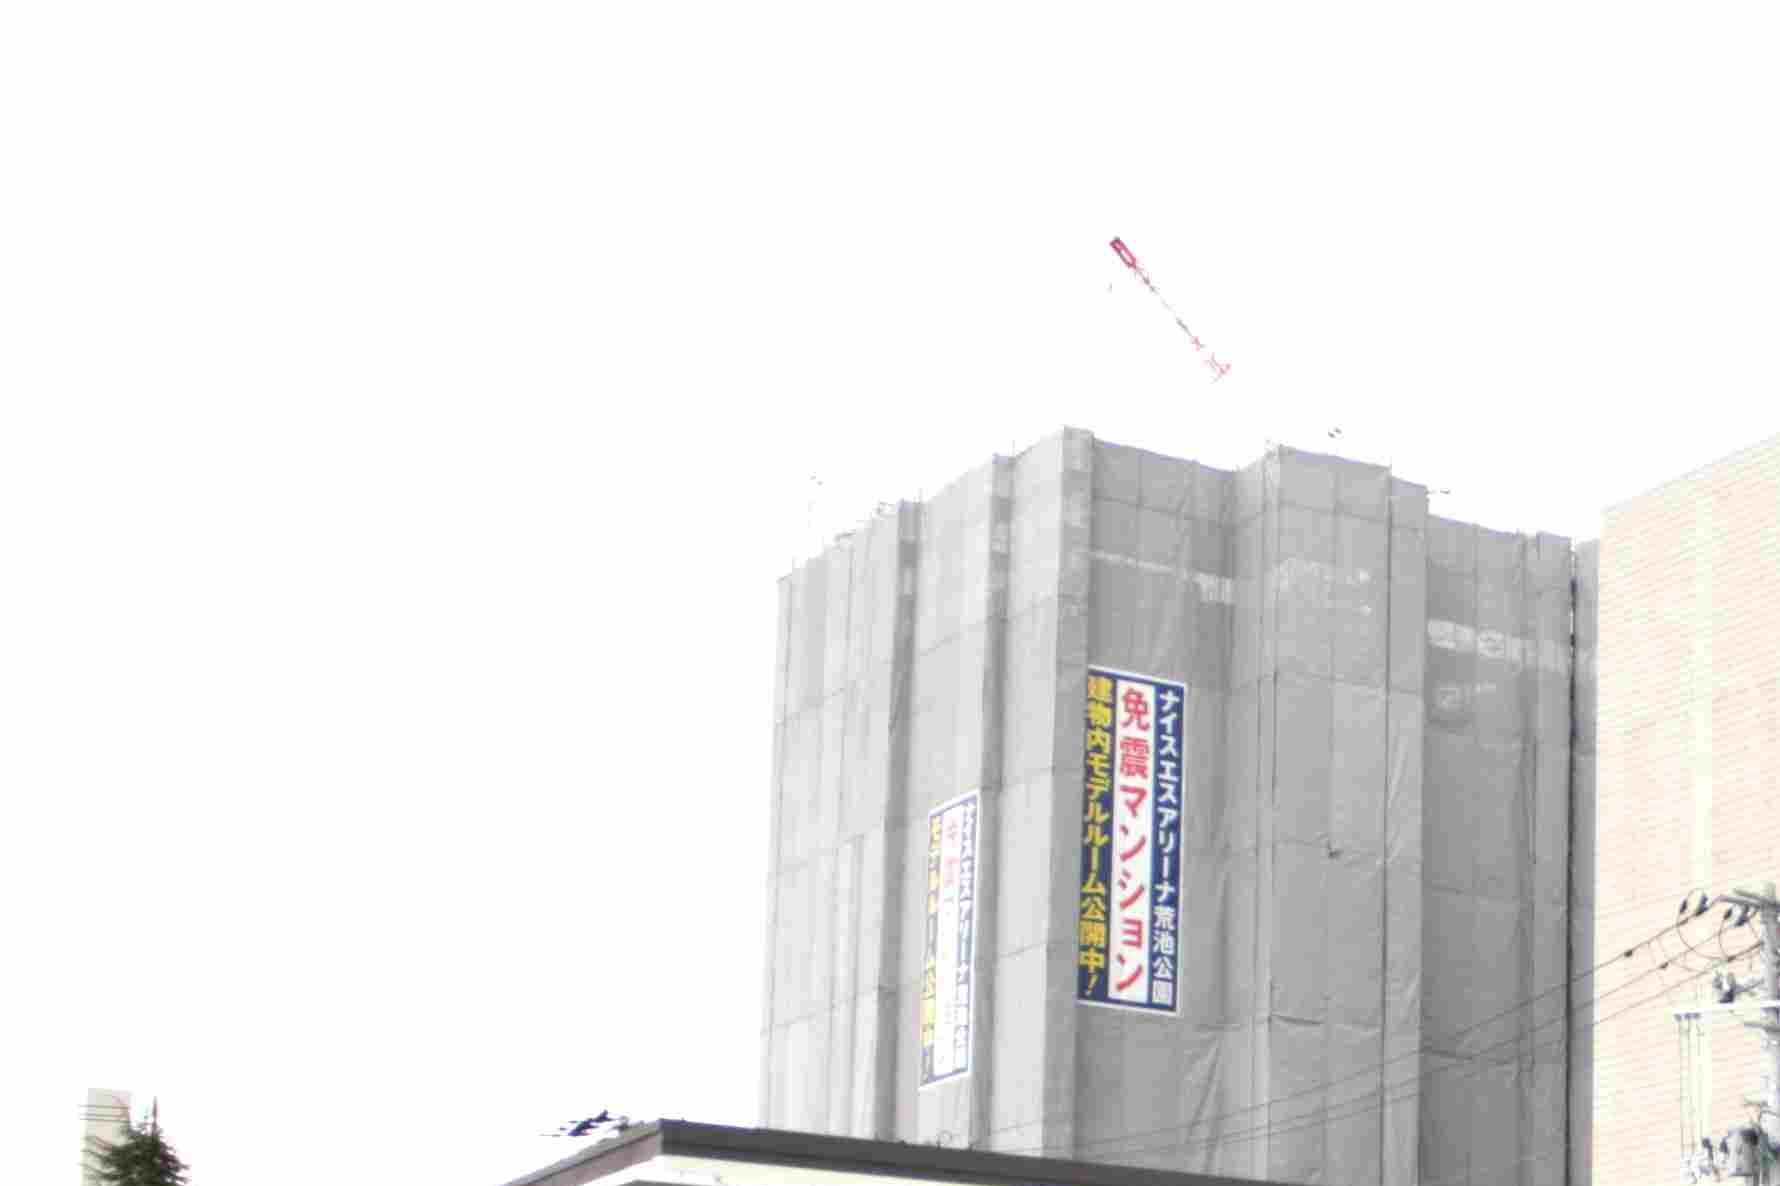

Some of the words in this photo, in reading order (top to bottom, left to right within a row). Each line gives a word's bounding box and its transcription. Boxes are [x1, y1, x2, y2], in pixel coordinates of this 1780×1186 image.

[1116, 687, 1149, 993] 免震マンション
